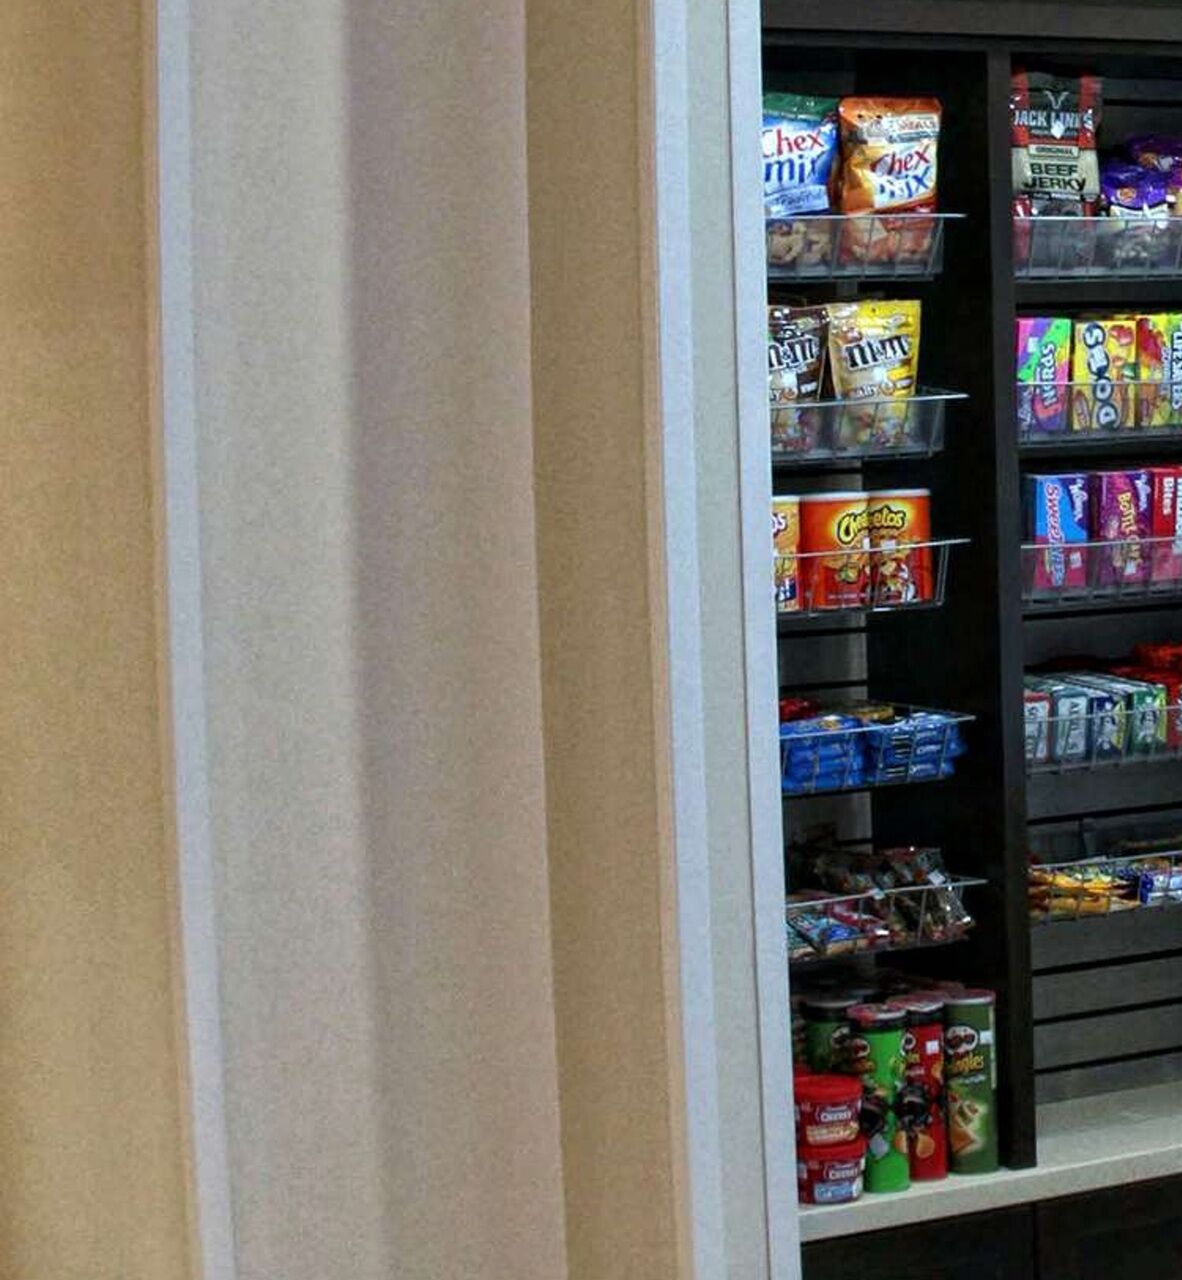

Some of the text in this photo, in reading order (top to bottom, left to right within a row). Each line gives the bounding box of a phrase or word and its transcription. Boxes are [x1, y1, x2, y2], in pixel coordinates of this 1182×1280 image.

[1029, 162, 1078, 176] BEEF
[1022, 176, 1086, 192] JERKY
[1162, 476, 1175, 516] Bites
